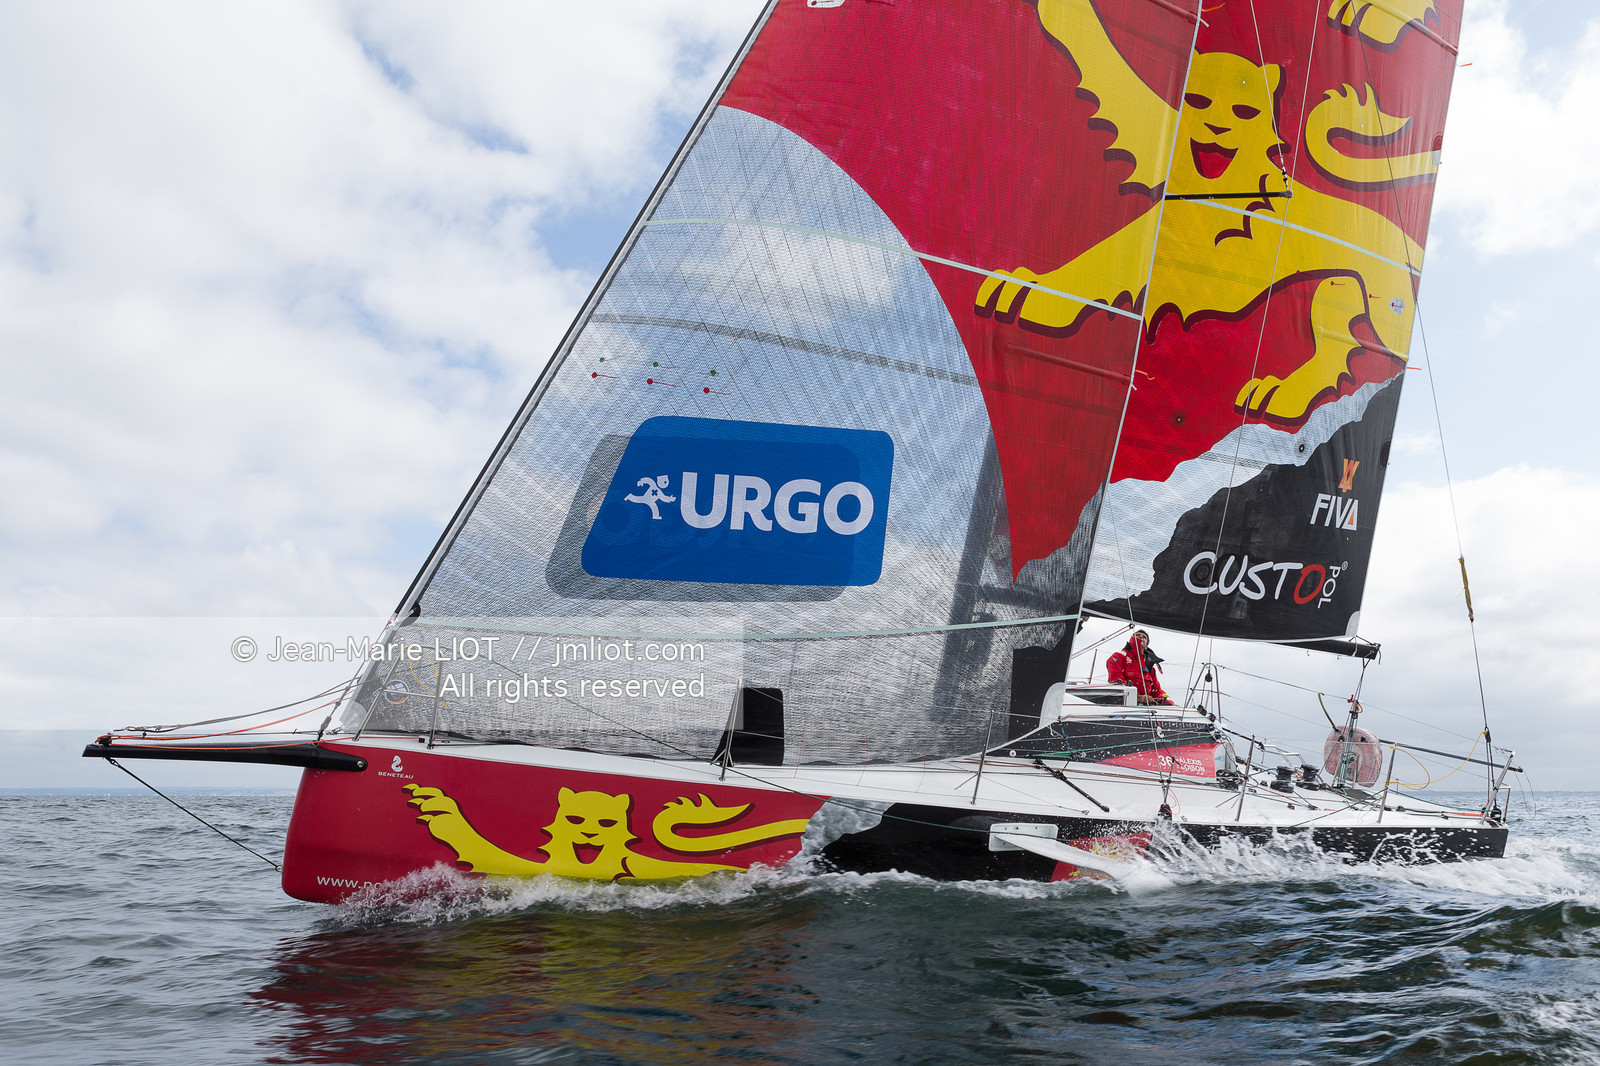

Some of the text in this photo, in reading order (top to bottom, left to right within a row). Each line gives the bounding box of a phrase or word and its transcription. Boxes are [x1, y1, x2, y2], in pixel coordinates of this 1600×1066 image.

[680, 471, 875, 536] URGO
[1309, 492, 1359, 531] FIVA
[1183, 550, 1326, 605] CUSTO
[1317, 565, 1342, 609] POL
[378, 771, 414, 780] BENETEAU
